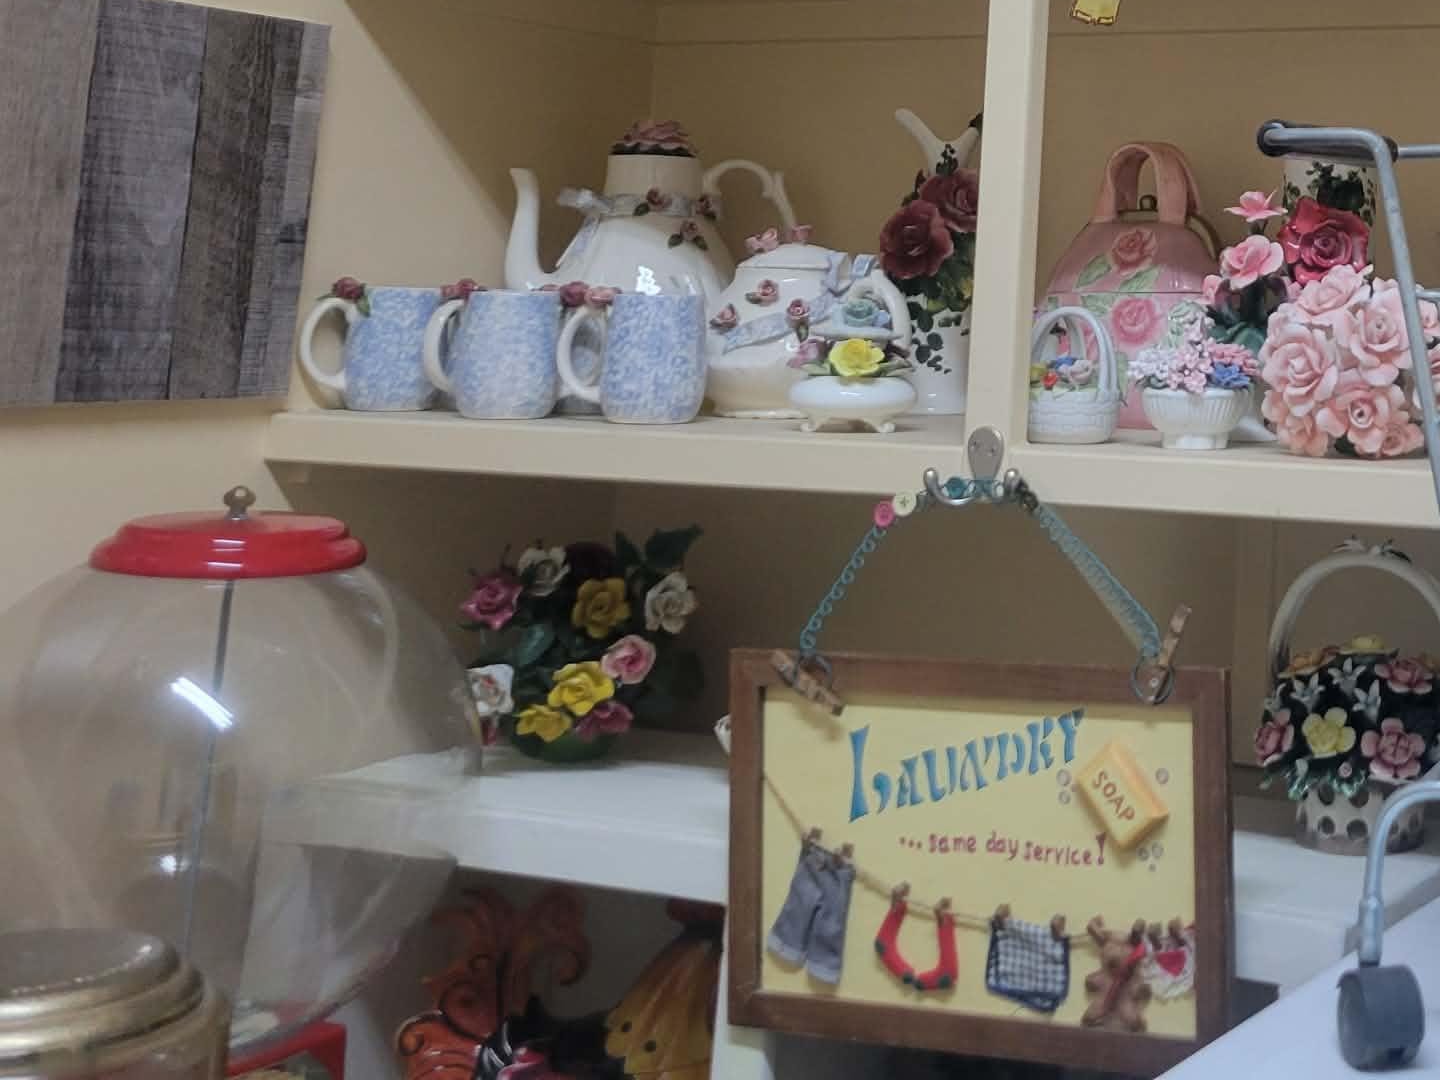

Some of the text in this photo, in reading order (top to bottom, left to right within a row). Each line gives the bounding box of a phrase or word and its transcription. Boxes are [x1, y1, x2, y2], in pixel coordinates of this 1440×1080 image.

[1091, 770, 1136, 823] SOAP
[985, 831, 1020, 861] day
[1023, 831, 1107, 866] service!
